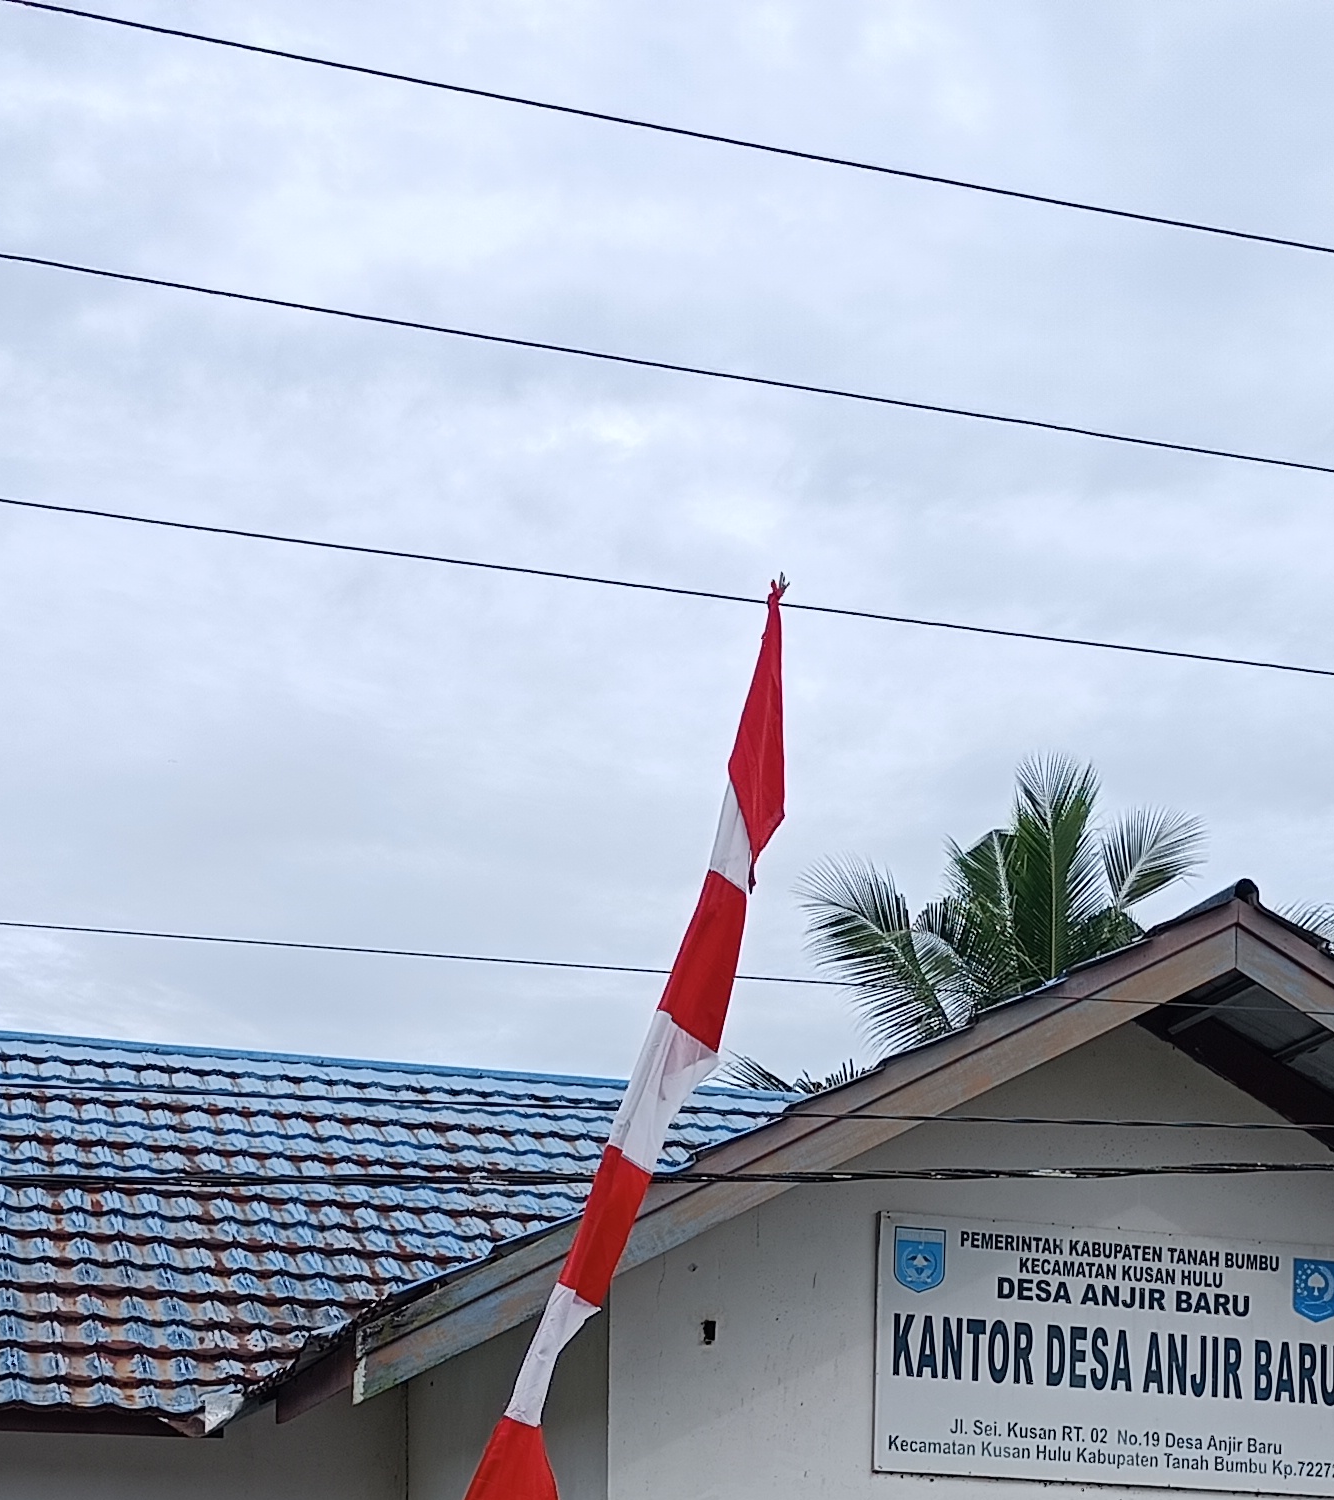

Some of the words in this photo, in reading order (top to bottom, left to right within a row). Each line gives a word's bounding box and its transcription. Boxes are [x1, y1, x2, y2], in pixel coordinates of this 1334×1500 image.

[960, 1230, 1064, 1256] PEMERINTAH
[1069, 1239, 1163, 1263] KABUPATEN
[1167, 1247, 1220, 1268] TANAH
[1224, 1252, 1280, 1272] BUMBU
[1019, 1257, 1117, 1280] KECAMATAN
[1121, 1264, 1176, 1285] KUSAN
[1180, 1269, 1224, 1288] HULU
[997, 1276, 1072, 1305] DESA
[1080, 1283, 1167, 1312] ANJIR
[1175, 1290, 1251, 1317] BARU
[892, 1312, 1033, 1385] KANTOR
[1046, 1323, 1132, 1393] DESA
[1143, 1331, 1243, 1401] ANJIR
[888, 1434, 976, 1457] Kecamatan
[981, 1441, 1031, 1460] Kusan
[1036, 1445, 1071, 1462] Hulu
[1076, 1447, 1159, 1469] Kabupaten
[1164, 1452, 1209, 1471] Tanah
[1214, 1455, 1267, 1474] Bumbu
[949, 1418, 968, 1435] Jl.
[973, 1419, 1003, 1437] Sei.
[1007, 1421, 1057, 1441] Kusan
[1062, 1425, 1086, 1443] RT.
[1090, 1427, 1108, 1444] 02
[1116, 1429, 1161, 1447] No.19
[1165, 1432, 1203, 1450] Desa
[1207, 1434, 1244, 1456] Anjir
[1247, 1437, 1283, 1455] Baru
